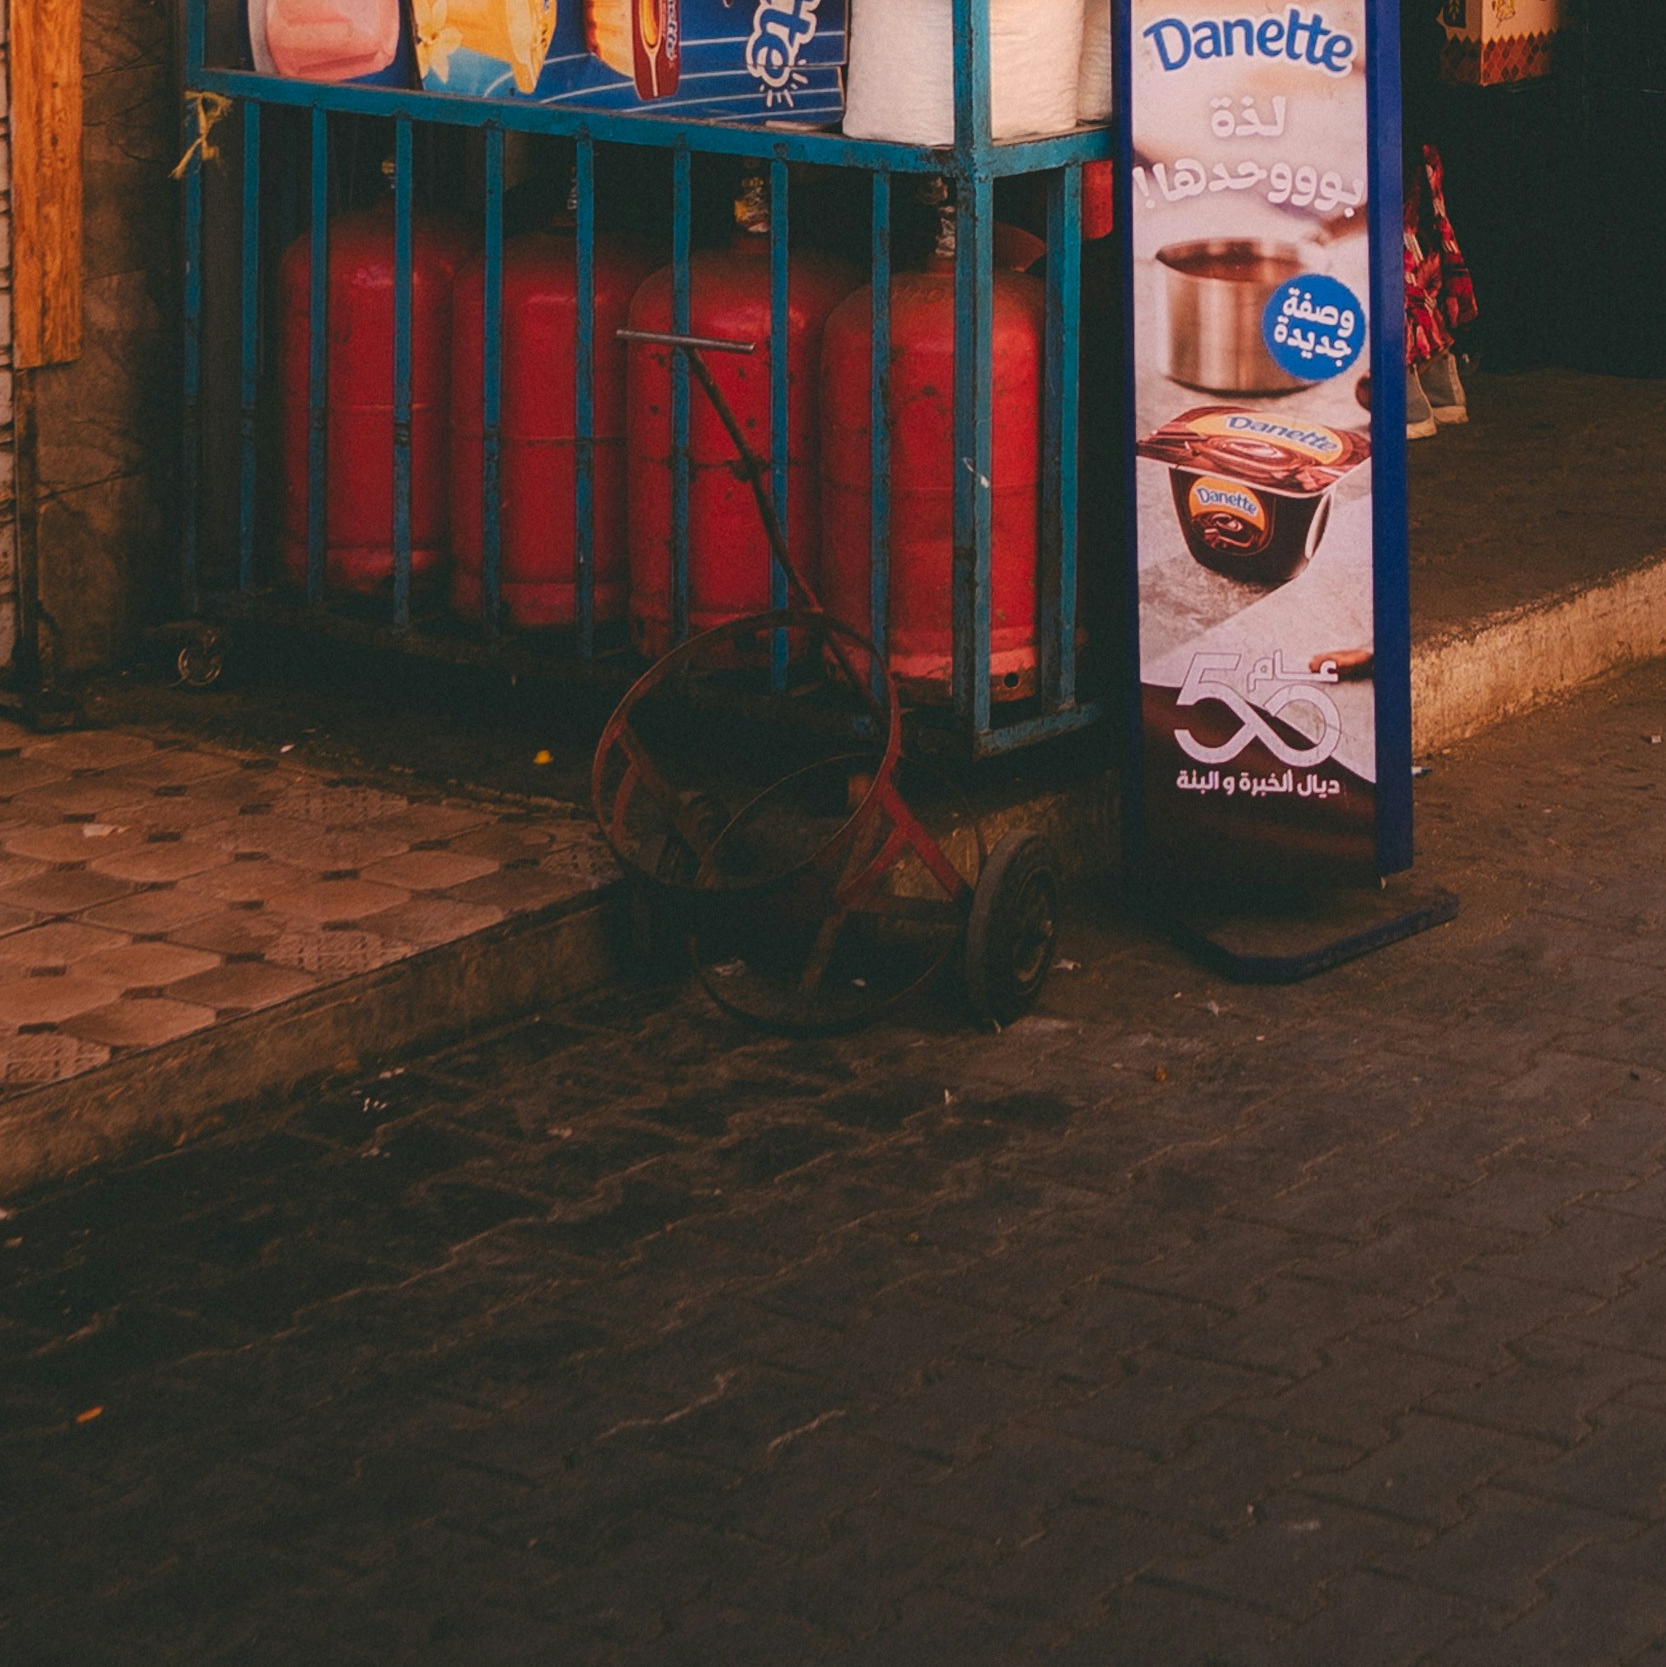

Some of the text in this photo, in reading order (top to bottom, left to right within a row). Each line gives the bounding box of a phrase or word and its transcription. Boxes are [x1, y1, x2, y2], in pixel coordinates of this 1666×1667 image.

[1143, 7, 1354, 74] Danette
[1210, 92, 1287, 138] لذة
[1132, 157, 1366, 219] بوووحدها!
[1282, 284, 1355, 338] وصفة
[1273, 316, 1354, 368] جديدة
[1224, 414, 1340, 455] Danette
[1196, 487, 1259, 519] Danette
[1246, 648, 1339, 692] عام
[1175, 768, 1341, 798] ديال الخبرة و البنة
